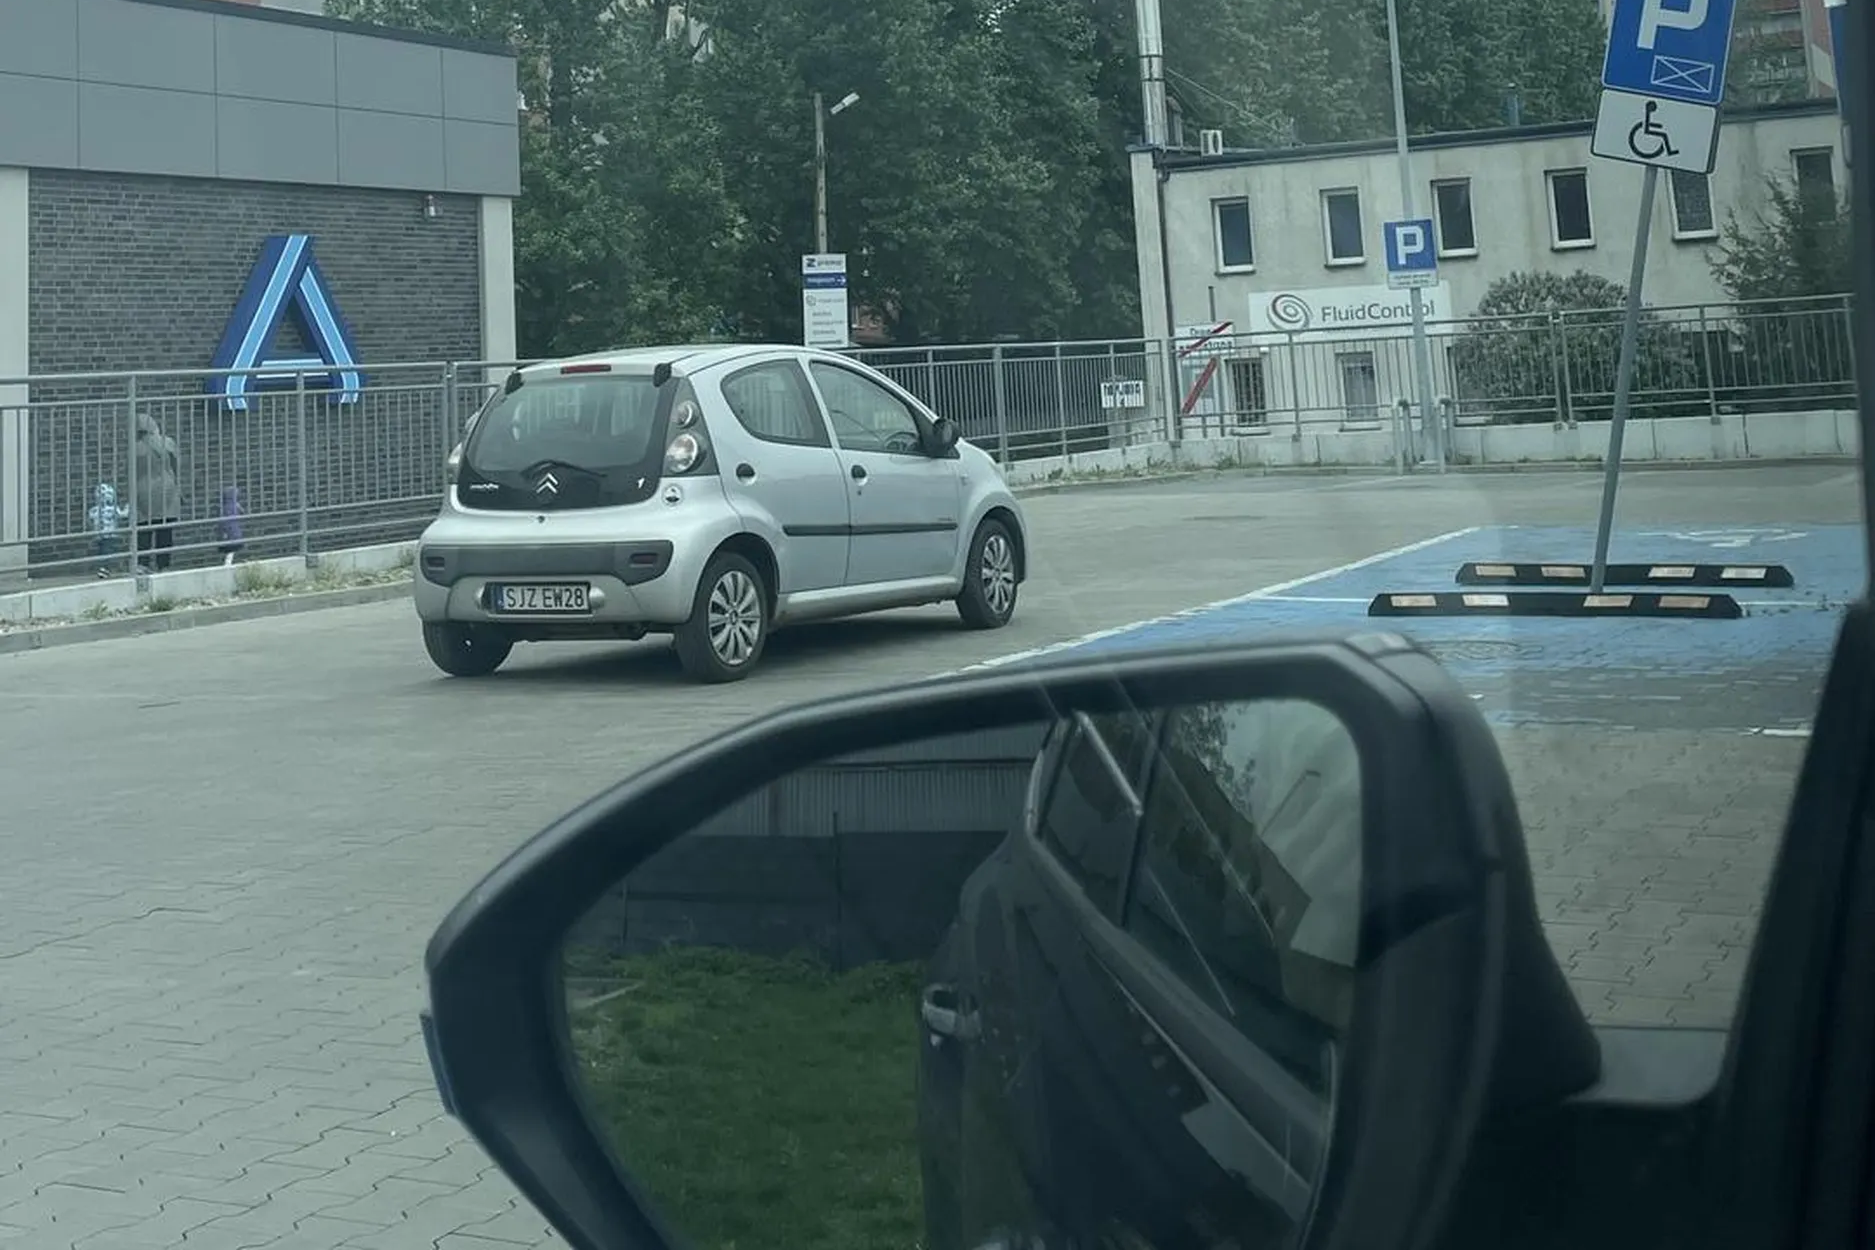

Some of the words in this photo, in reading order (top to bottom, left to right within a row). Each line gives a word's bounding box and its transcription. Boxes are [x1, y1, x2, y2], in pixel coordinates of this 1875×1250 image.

[1396, 225, 1424, 265] P
[207, 234, 368, 412] A
[1320, 299, 1436, 323] FluidContol
[506, 588, 538, 608] SJZ
[542, 588, 584, 608] EW28
